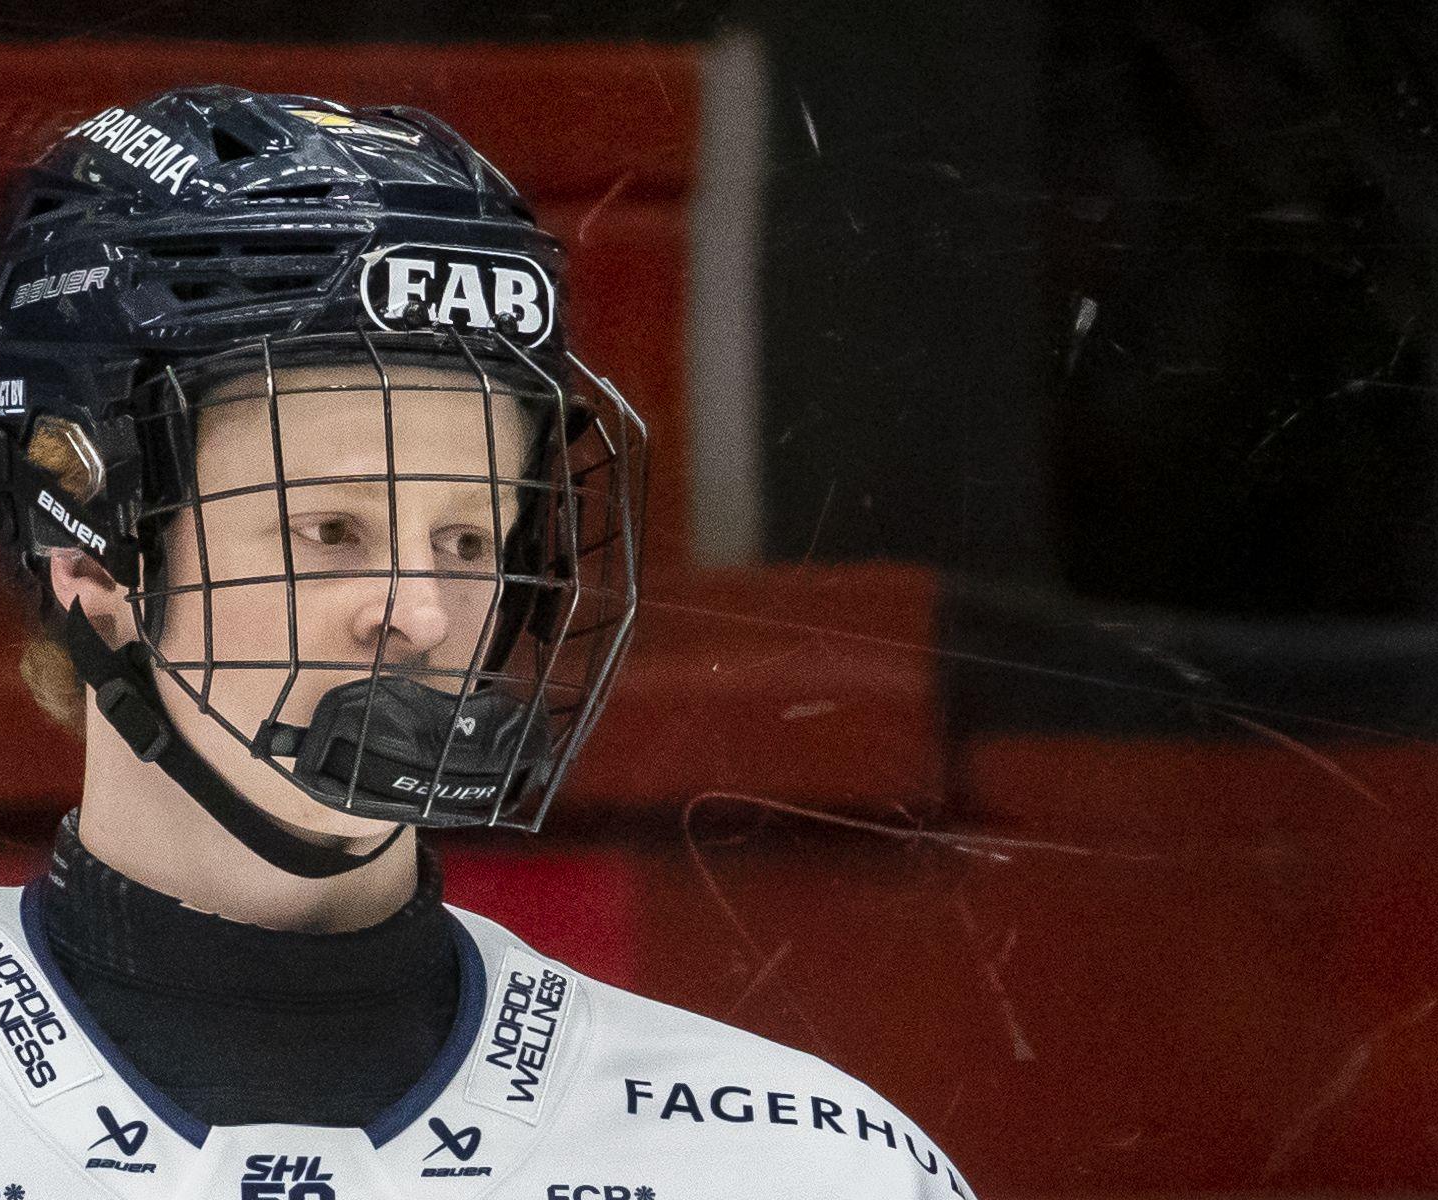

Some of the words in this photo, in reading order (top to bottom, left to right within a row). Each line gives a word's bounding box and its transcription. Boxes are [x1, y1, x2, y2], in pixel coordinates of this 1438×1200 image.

[485, 970, 536, 1070] NORDIC
[506, 969, 568, 1102] WELLNESS
[241, 1154, 333, 1181] SHL
[625, 1078, 967, 1200] FAGERHUL
